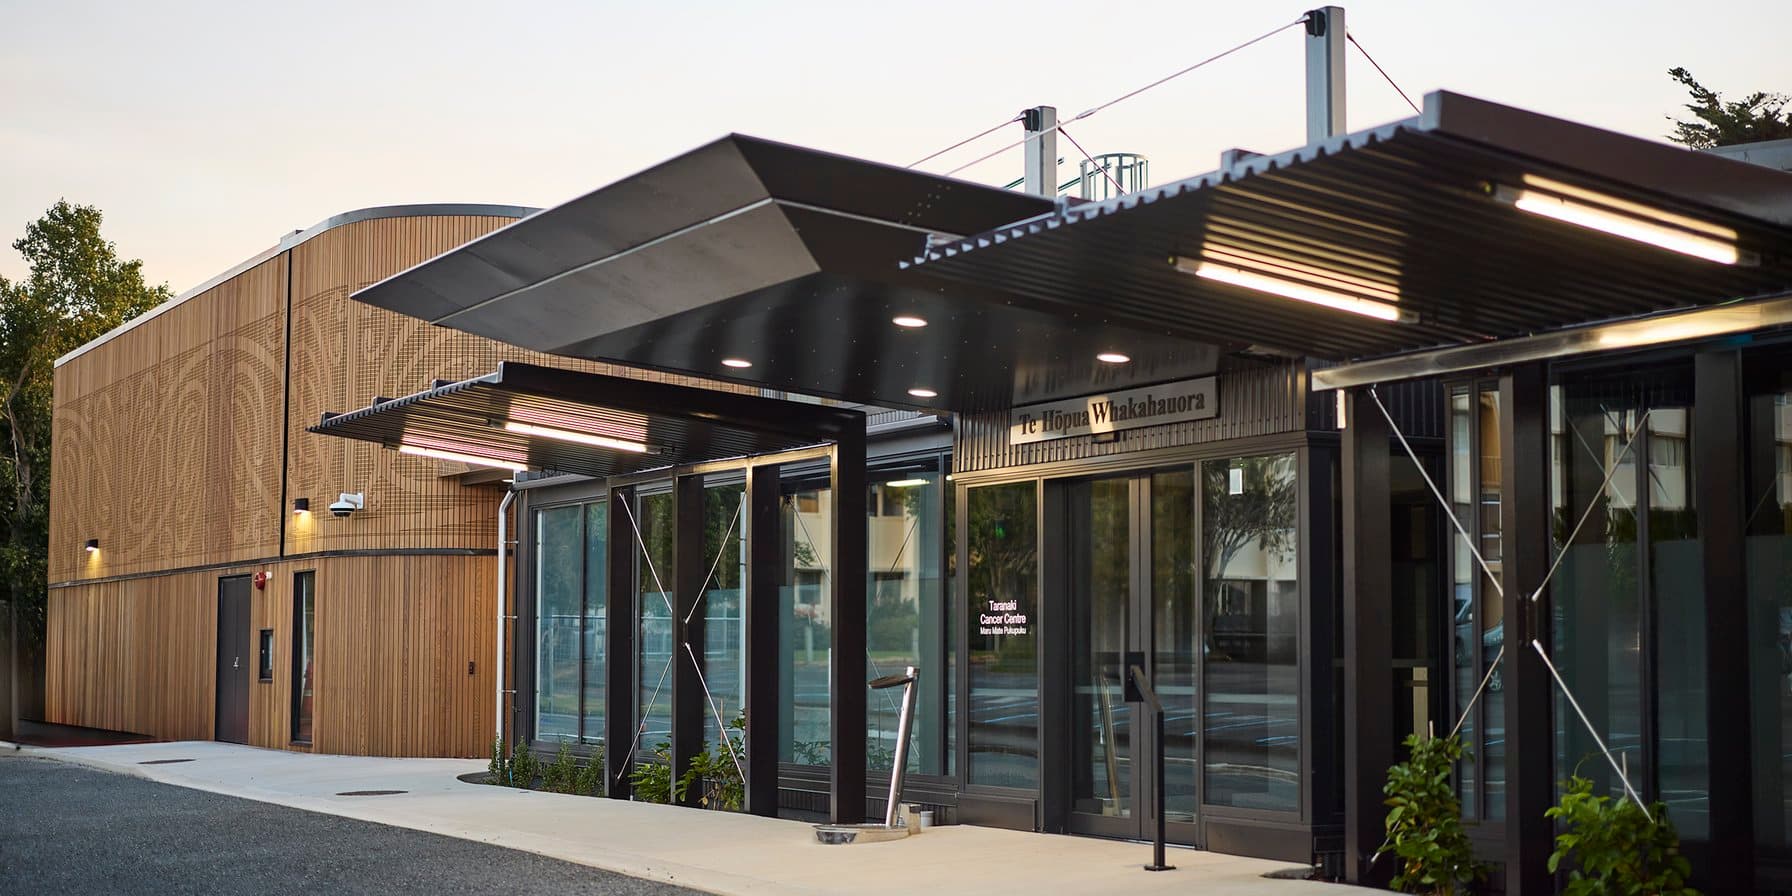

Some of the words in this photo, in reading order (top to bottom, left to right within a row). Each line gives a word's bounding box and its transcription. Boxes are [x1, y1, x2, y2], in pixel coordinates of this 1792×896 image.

[1019, 414, 1037, 435] Te
[1042, 410, 1090, 436] Hōpua
[1092, 392, 1206, 424] Whakahauora
[989, 599, 1017, 611] Taranaki
[980, 613, 1003, 624] Cancer
[1004, 612, 1027, 624] Centre
[980, 626, 991, 634] Maru
[992, 626, 1003, 634] Mate
[1004, 626, 1027, 636] Pukupuku
